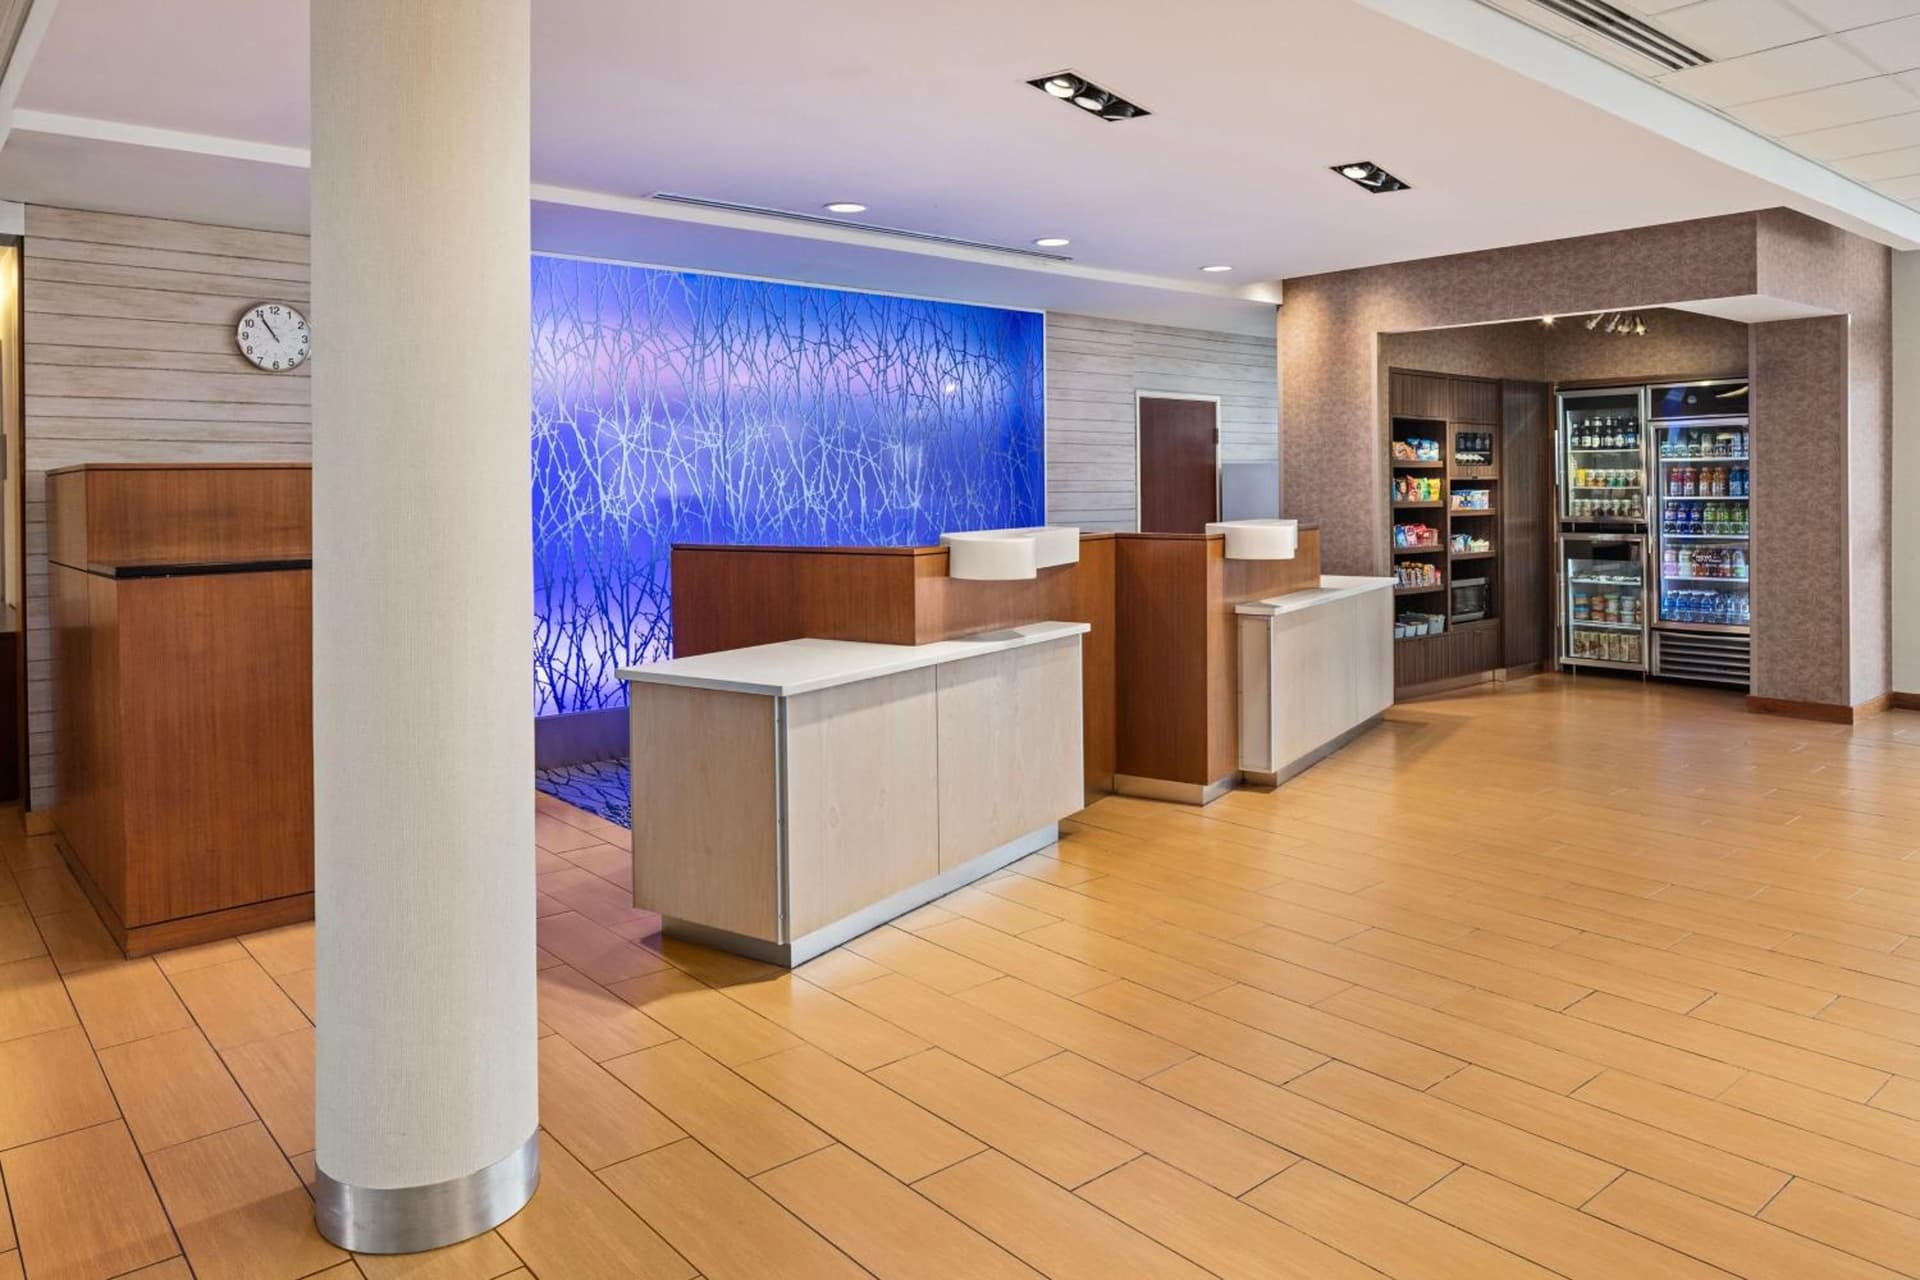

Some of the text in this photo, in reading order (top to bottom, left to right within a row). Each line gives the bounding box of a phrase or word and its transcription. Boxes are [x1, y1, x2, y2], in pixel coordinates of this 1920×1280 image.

[269, 306, 280, 315] 12
[287, 311, 291, 320] 1
[245, 319, 254, 328] 10
[297, 321, 304, 329] 2
[242, 332, 249, 340] 9
[301, 335, 308, 343] 3
[246, 346, 253, 354] 8
[257, 356, 264, 365] 7
[288, 358, 295, 367] 5
[272, 361, 280, 369] 6
